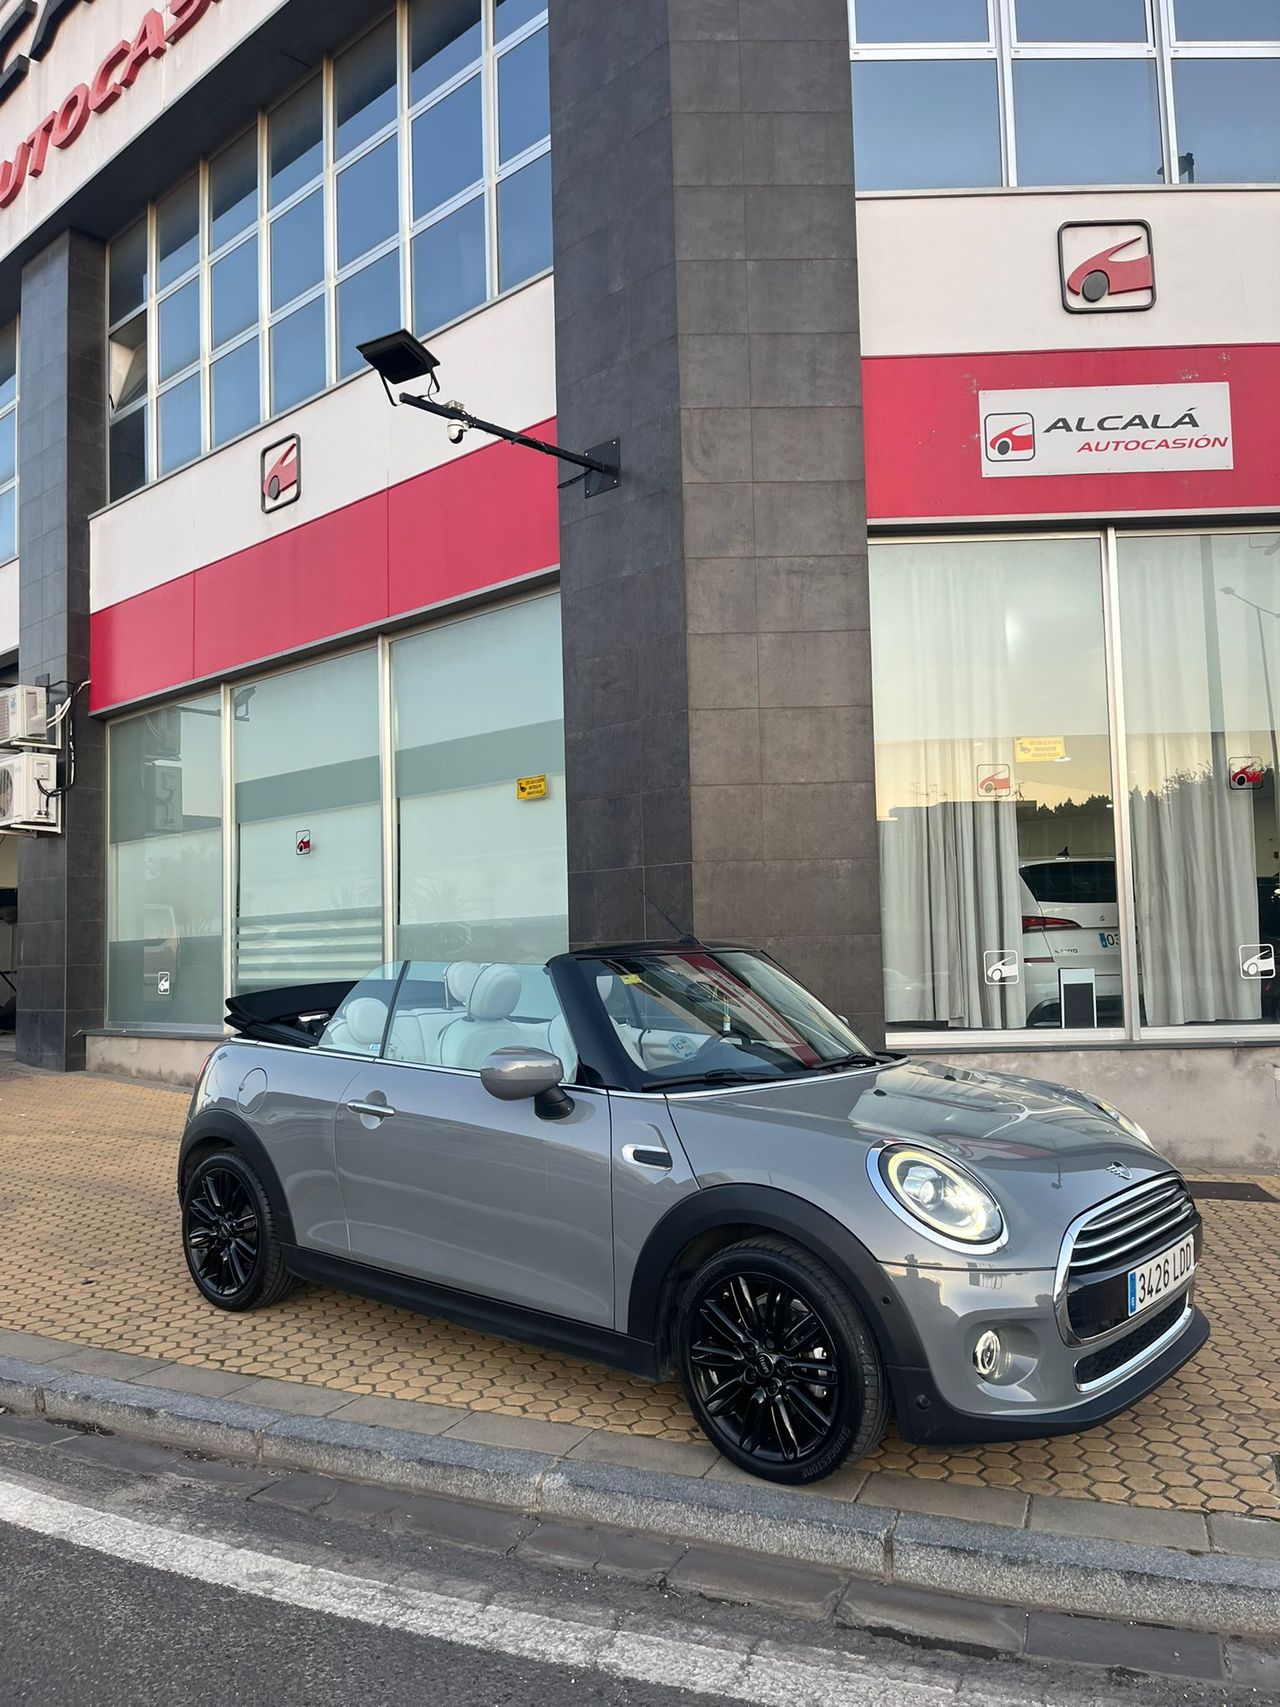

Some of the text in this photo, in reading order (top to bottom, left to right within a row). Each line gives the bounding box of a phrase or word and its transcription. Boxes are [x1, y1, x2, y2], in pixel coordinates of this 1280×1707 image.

[1043, 407, 1200, 433] ALCALÁ
[1077, 434, 1229, 453] AUTOCASIÓN
[1139, 1242, 1192, 1303] 3426 LDD
